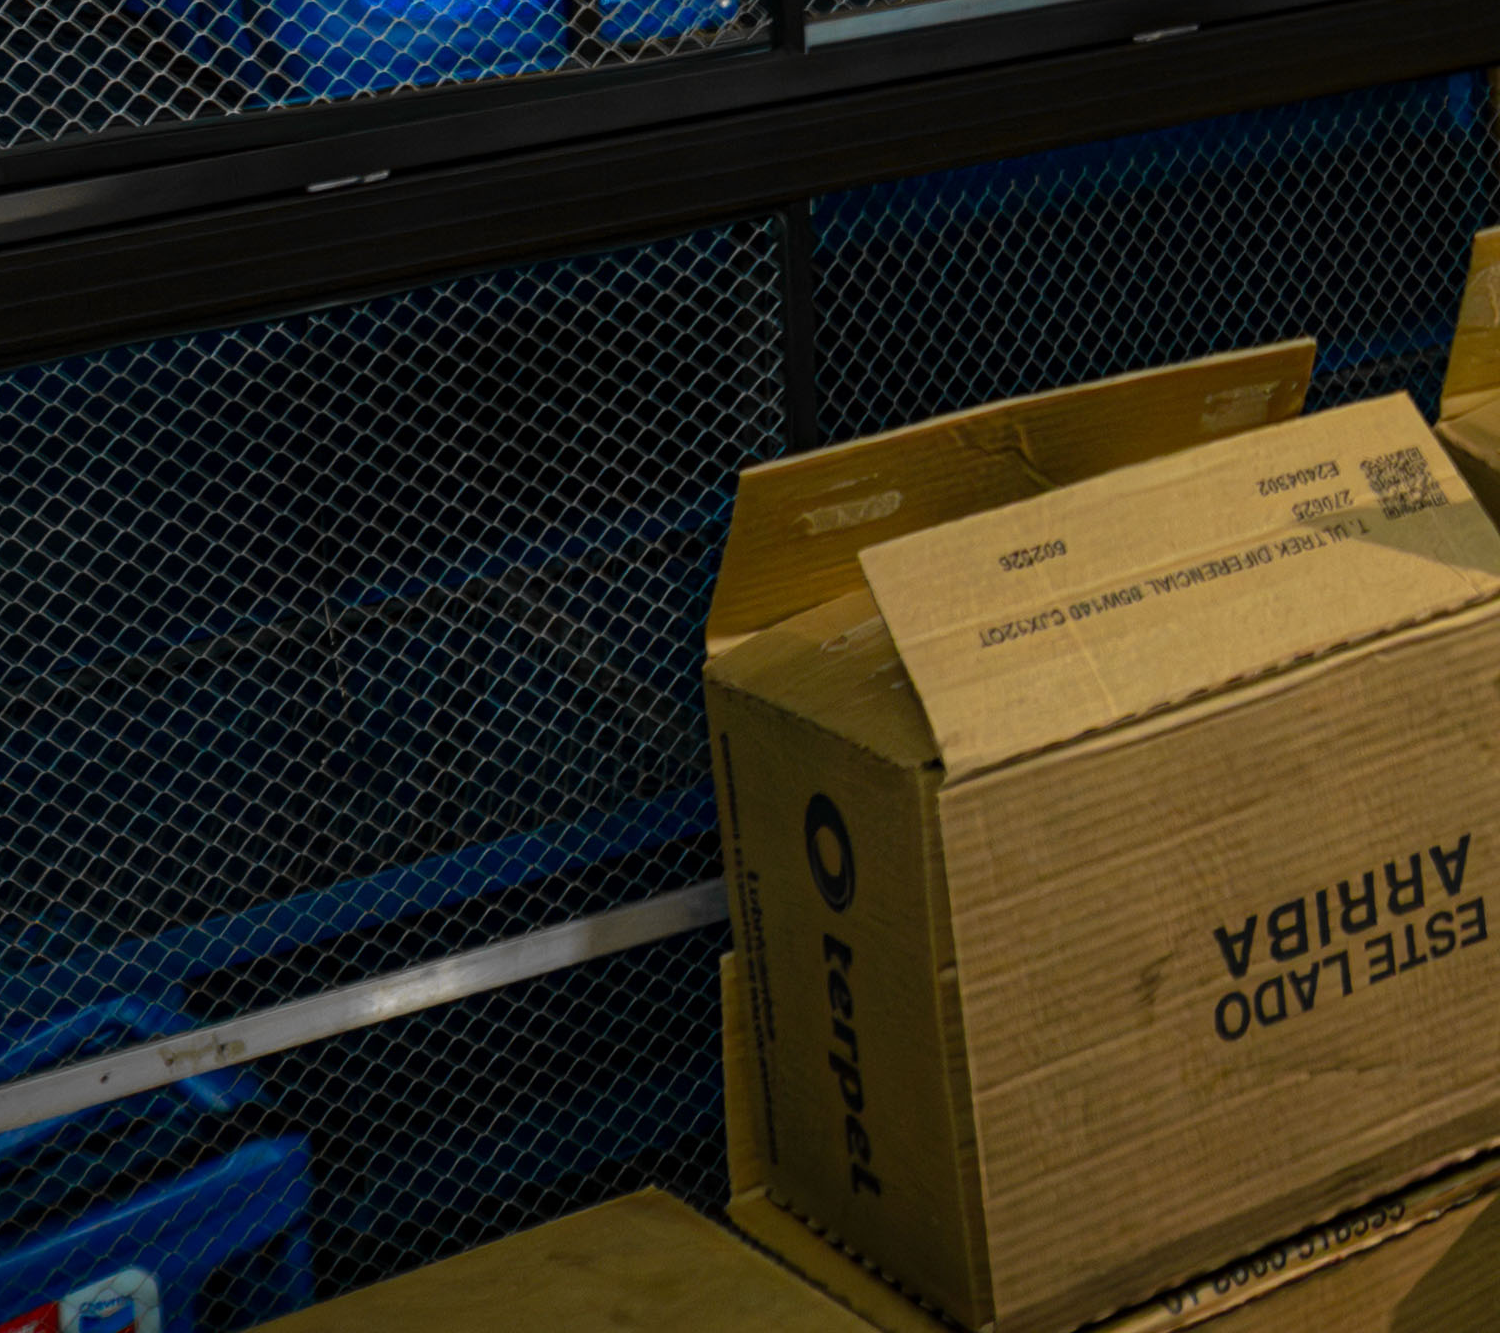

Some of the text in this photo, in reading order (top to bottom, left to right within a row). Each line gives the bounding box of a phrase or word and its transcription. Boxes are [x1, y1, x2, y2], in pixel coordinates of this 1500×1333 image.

[1273, 522, 1349, 560] ULTREK
[1291, 489, 1355, 522] 270625
[1144, 546, 1273, 596] DIFERENCIAL
[1213, 833, 1474, 980] ARRIBA
[1213, 896, 1489, 1043] ESTE LADO
[823, 938, 883, 1200] terpel
